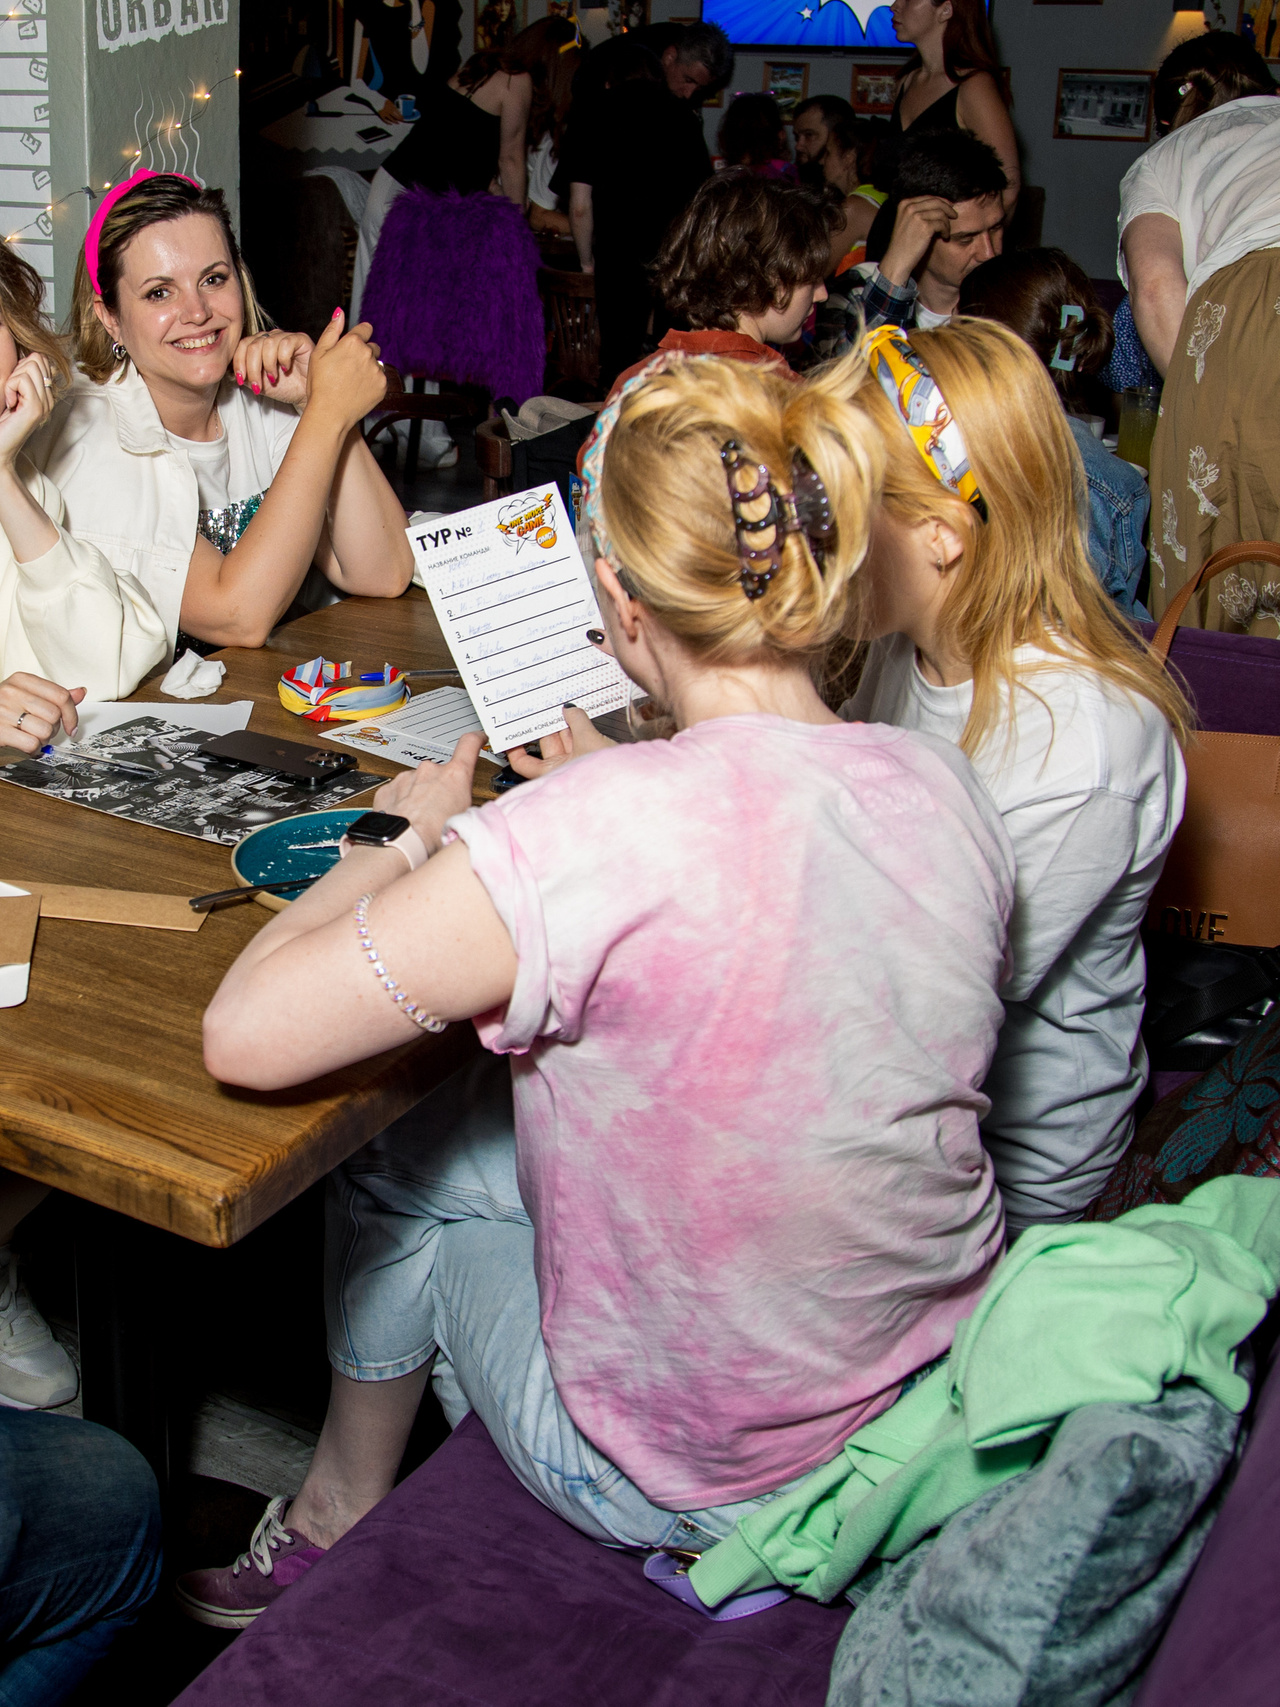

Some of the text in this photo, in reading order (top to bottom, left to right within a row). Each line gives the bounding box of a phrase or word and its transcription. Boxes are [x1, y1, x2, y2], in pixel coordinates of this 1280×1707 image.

[509, 516, 524, 530] ONE
[524, 505, 545, 522] MORE
[516, 514, 546, 538] GAME
[416, 528, 452, 552] ТУР
[427, 556, 460, 571] НАЗВАНИЕ
[534, 717, 565, 731] #ONEMORE
